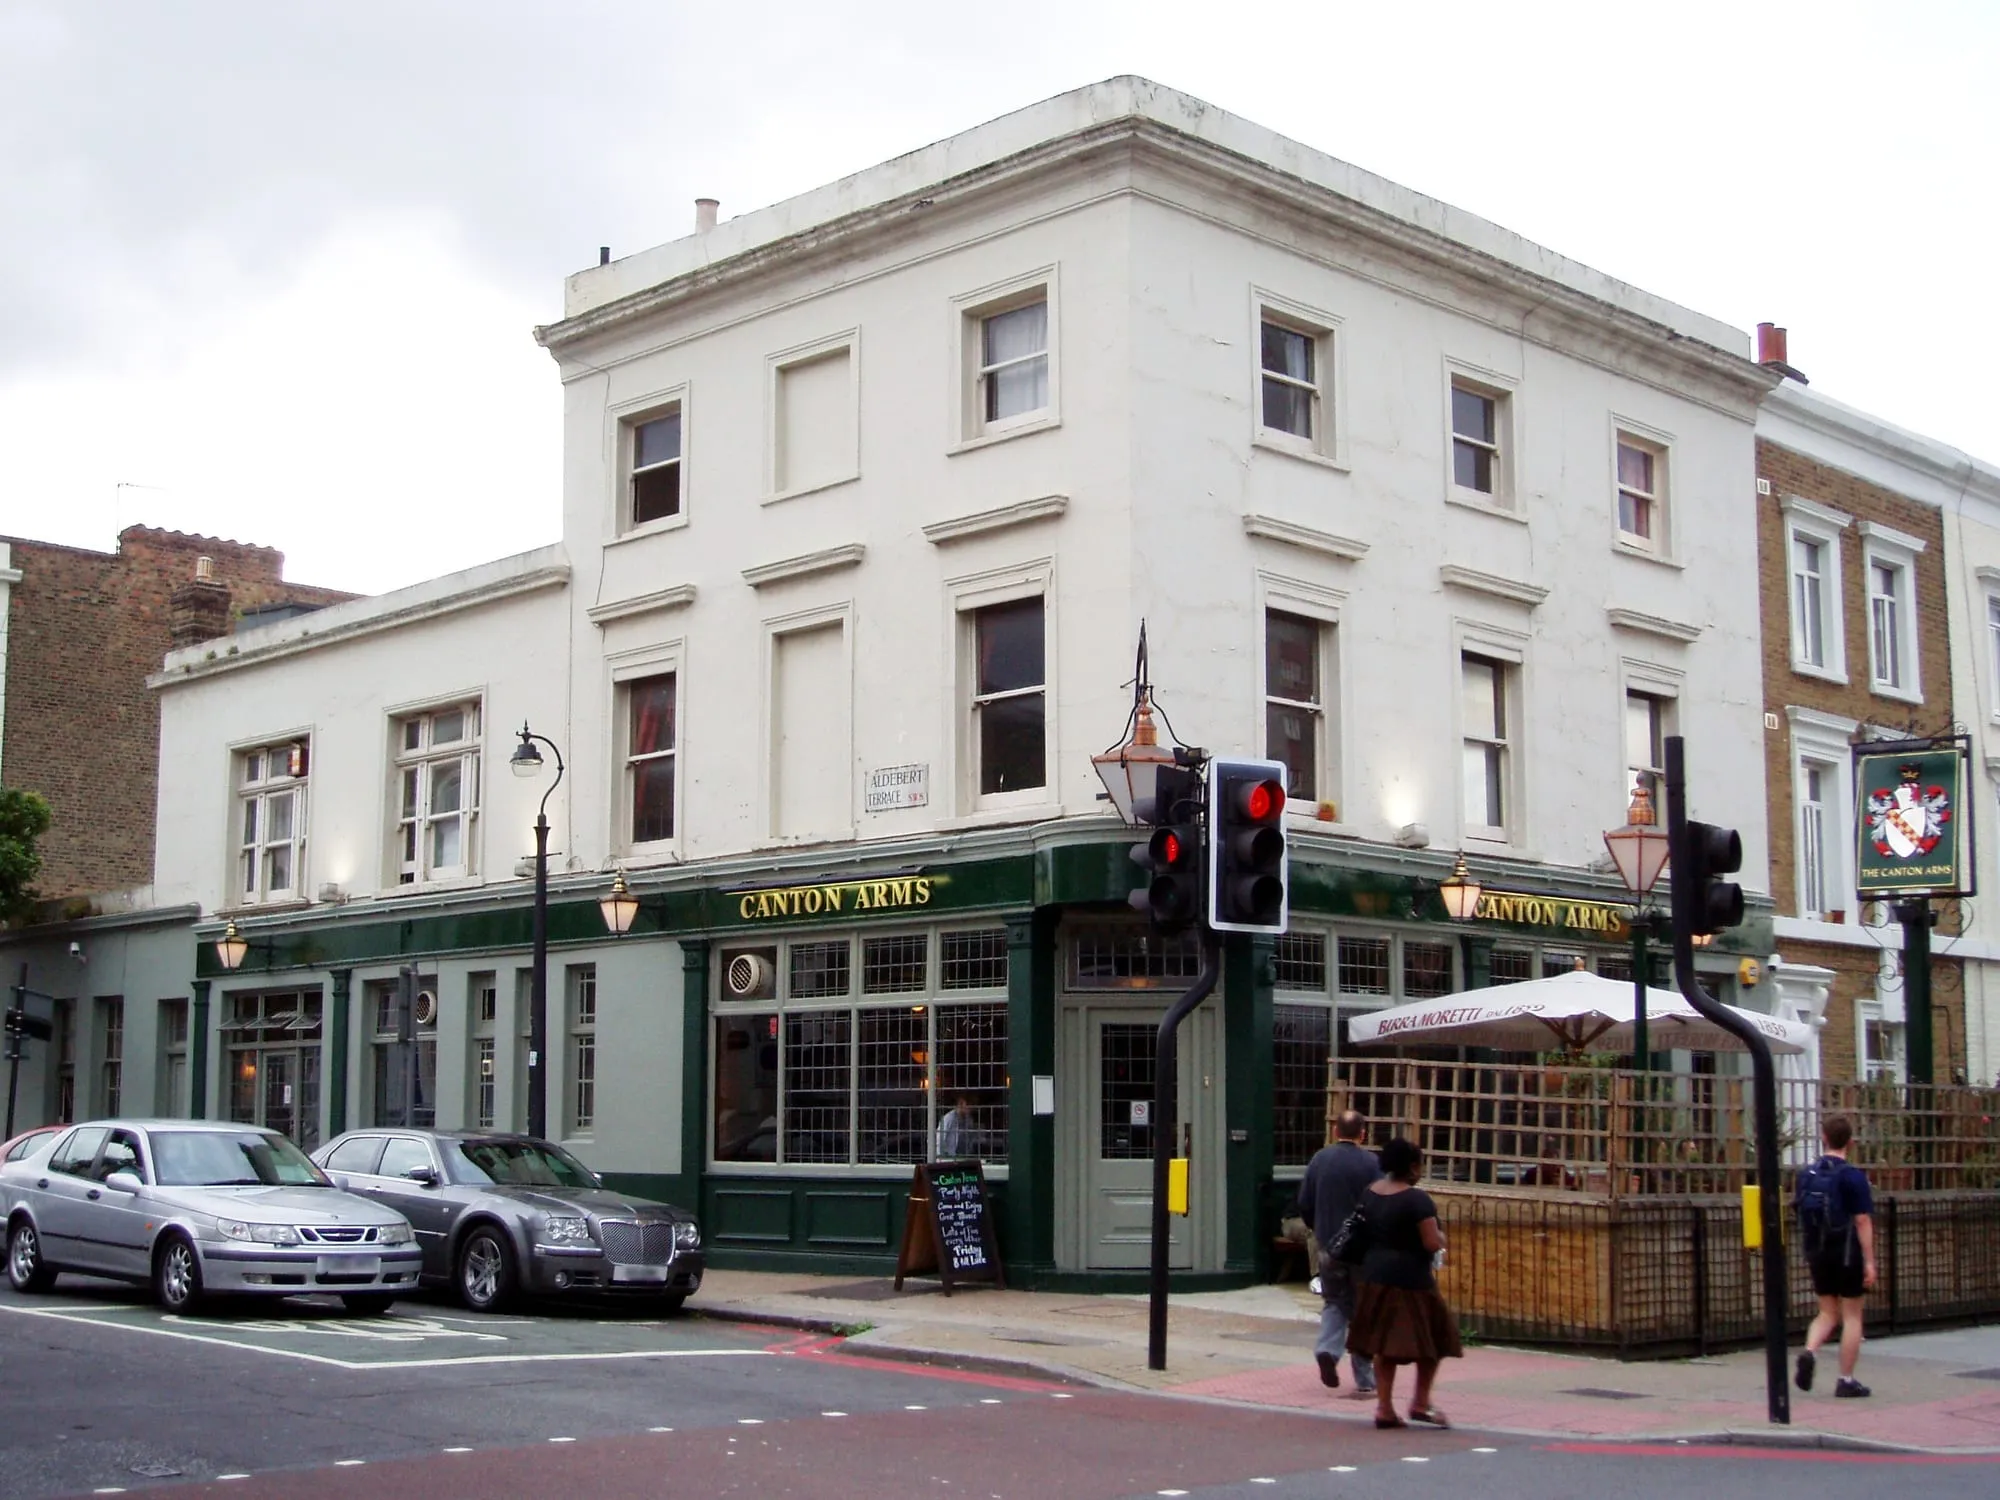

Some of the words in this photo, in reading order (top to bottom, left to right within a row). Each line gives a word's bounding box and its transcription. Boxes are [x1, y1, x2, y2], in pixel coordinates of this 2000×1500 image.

[871, 769, 924, 788] ALDEBERT
[868, 790, 901, 806] TERRACE
[1862, 868, 1879, 878] THE
[1881, 866, 1924, 877] CANTON
[1926, 864, 1953, 875] ARMS
[740, 888, 842, 919] CANTON
[854, 878, 931, 910] ARMS
[1474, 894, 1556, 926] CANTON
[1565, 904, 1622, 933] ARMS
[1377, 1015, 1416, 1035] BIRRA
[1418, 1007, 1483, 1030] MORETTI
[1758, 1018, 1788, 1038] 1859
[953, 1244, 982, 1259] Friday
